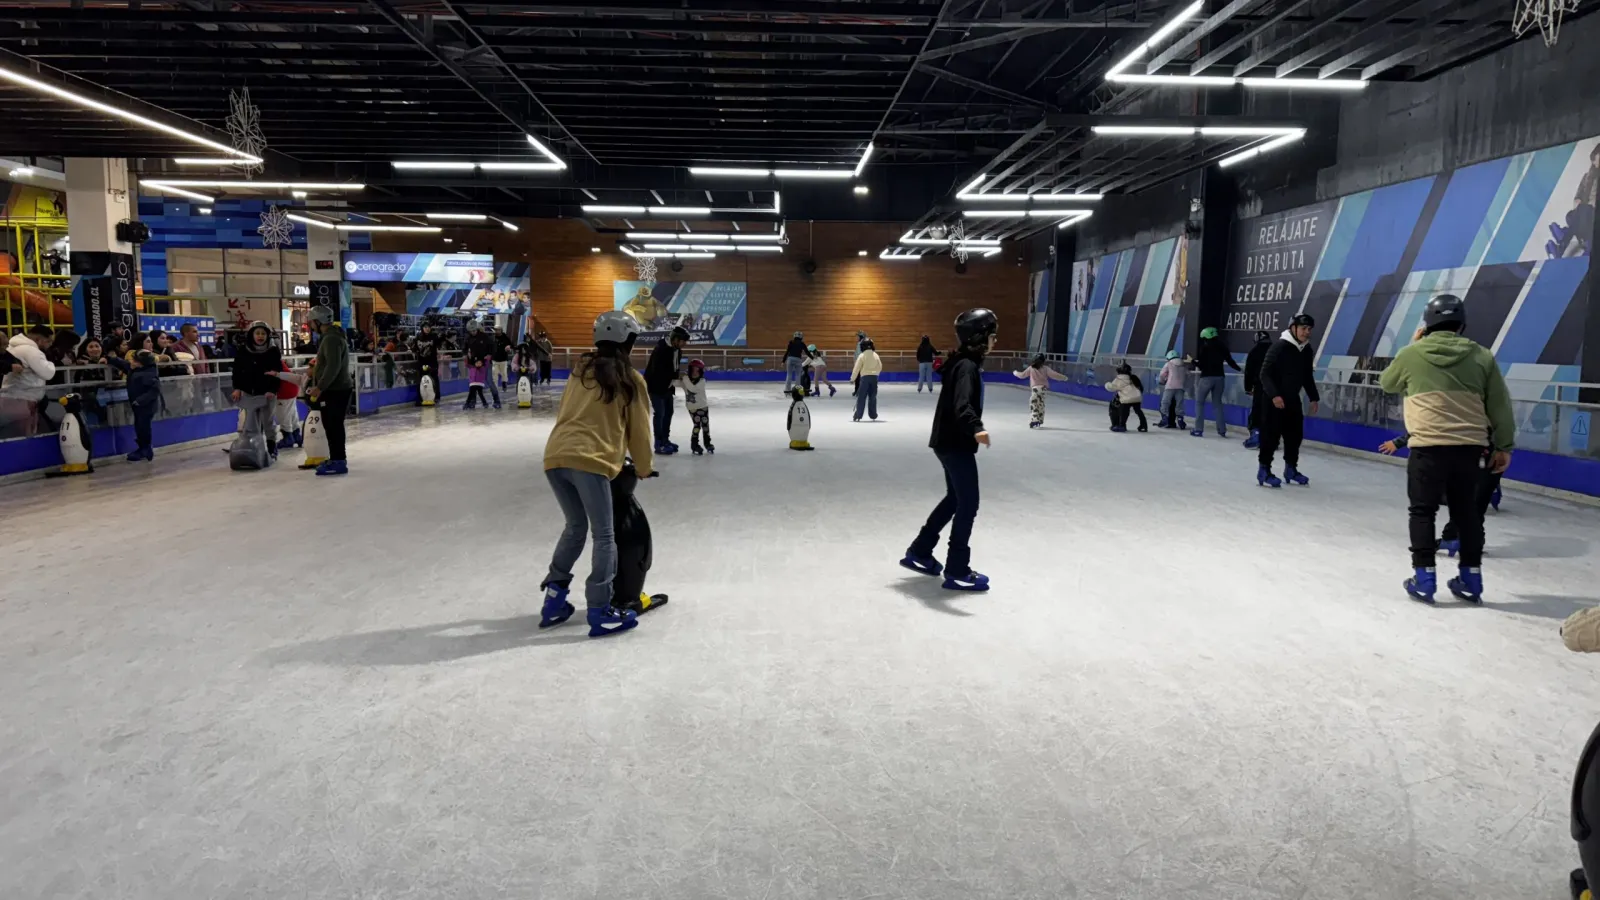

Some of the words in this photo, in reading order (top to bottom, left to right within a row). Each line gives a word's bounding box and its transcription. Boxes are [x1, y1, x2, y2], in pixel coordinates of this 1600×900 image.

[1258, 217, 1318, 245] RELÁJATE
[1246, 249, 1304, 274] DISFRUTA
[117, 261, 134, 343] ogrado
[1236, 281, 1292, 302] CELEBRA
[91, 286, 102, 340] EROGRADO.CL
[1226, 311, 1279, 330] APRENDE
[308, 416, 320, 425] 29
